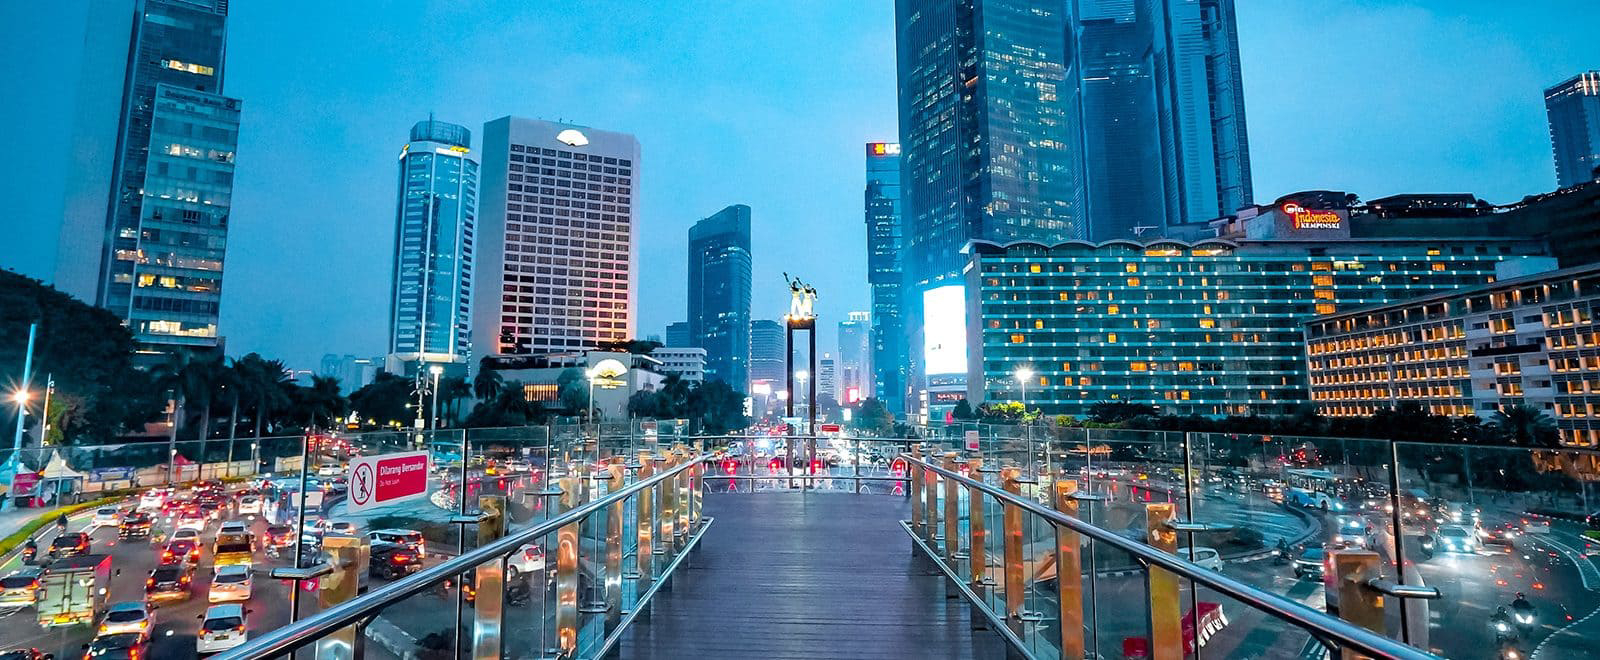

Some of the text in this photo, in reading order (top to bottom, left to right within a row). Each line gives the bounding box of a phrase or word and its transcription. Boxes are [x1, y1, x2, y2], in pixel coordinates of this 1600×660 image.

[1284, 203, 1341, 229] Indonesia
[380, 462, 424, 476] Dilarang Bersandar
